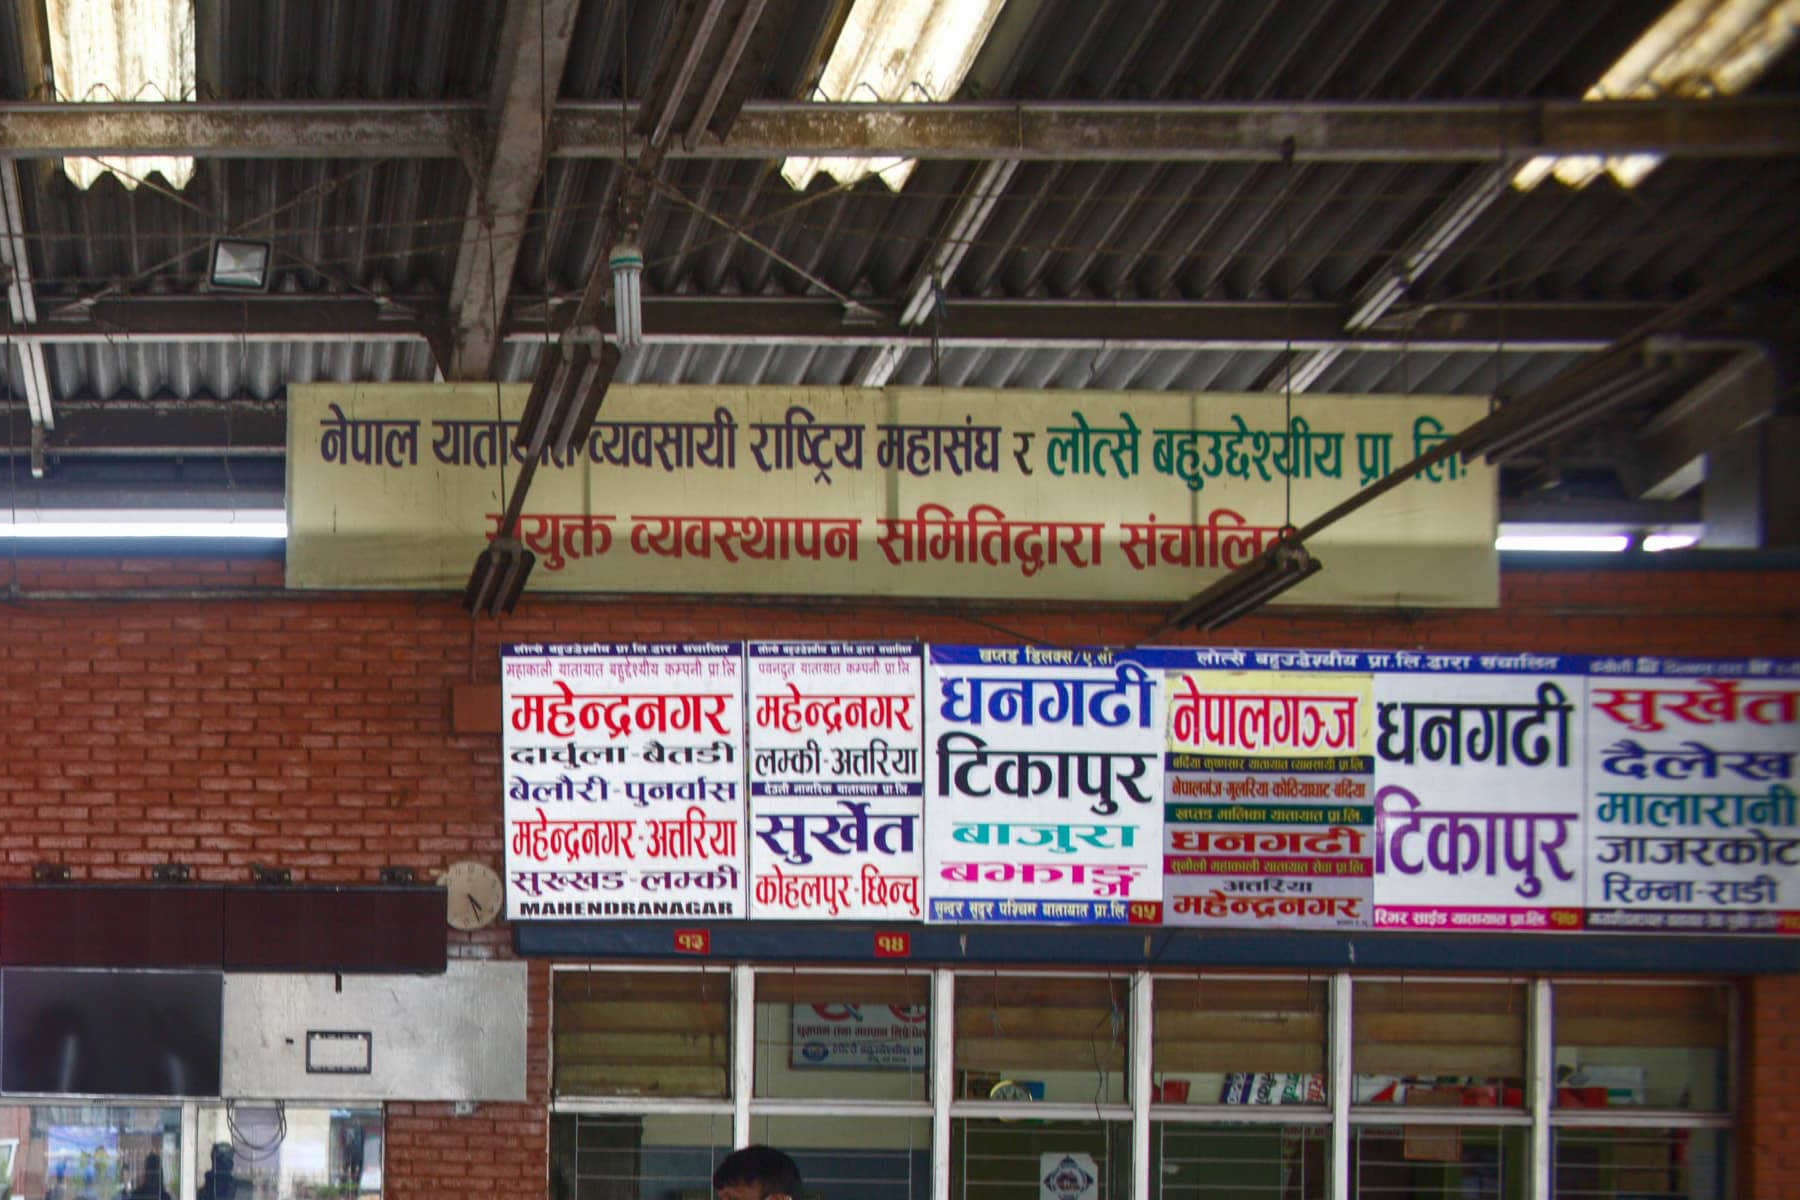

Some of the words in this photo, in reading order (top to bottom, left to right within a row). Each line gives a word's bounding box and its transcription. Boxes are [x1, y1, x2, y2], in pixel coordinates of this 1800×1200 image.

[320, 404, 420, 467] नेपाल
[588, 406, 738, 472] व्यवसायी
[749, 405, 865, 483] राष्ट्रिय
[877, 415, 1001, 475] महासंघ
[1013, 431, 1035, 475] र
[1047, 411, 1141, 476] लोत्से
[631, 513, 861, 564] व्यवस्थापन
[877, 502, 1105, 577] समितिद्वारा
[511, 680, 733, 739] महेन्द्रनगर
[756, 682, 916, 735] महेन्द्रनगर
[940, 662, 1158, 728] धनगढी
[1173, 675, 1359, 750] नेपालगञ्ज
[1376, 681, 1574, 767] धनगढी
[1591, 677, 1800, 733] सुर्खेत
[936, 730, 1158, 816] टिकापुर
[1601, 739, 1799, 780] दैलेख
[756, 800, 920, 865] सुर्खेत
[1597, 784, 1799, 828] मालारानी
[952, 822, 1140, 854] बाजुरा
[1171, 826, 1366, 854] धनगढी
[1375, 784, 1579, 898] टिकापुर
[519, 901, 734, 916] MAHENDRANAGAR
[1173, 889, 1364, 919] महेन्द्रनगर
